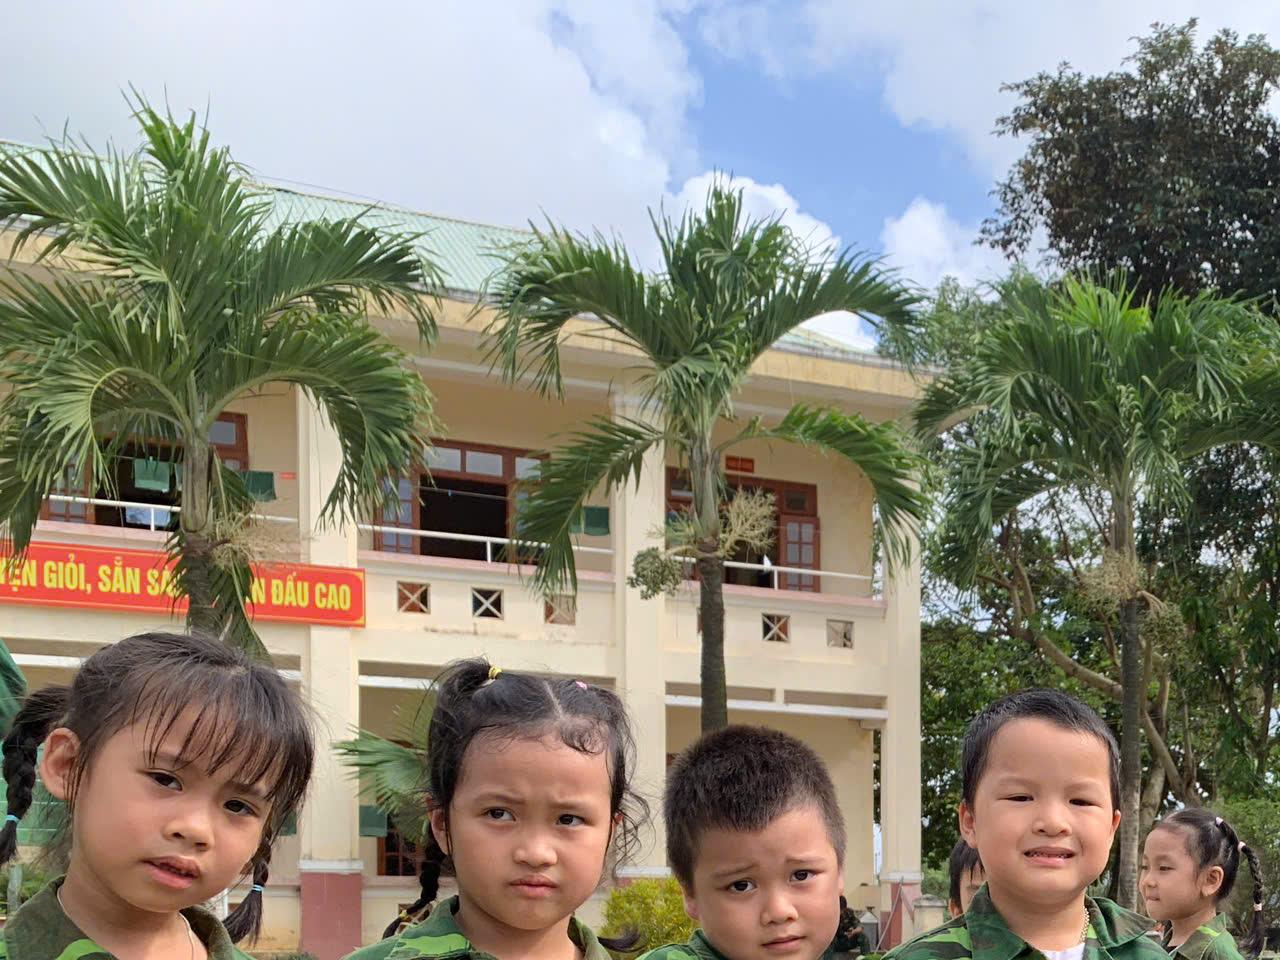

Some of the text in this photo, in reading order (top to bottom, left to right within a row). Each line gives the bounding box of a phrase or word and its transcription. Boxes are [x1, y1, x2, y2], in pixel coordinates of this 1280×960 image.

[43, 553, 92, 595] GIỎI,
[271, 572, 309, 608] ĐẤU
[315, 582, 351, 611] CAO
